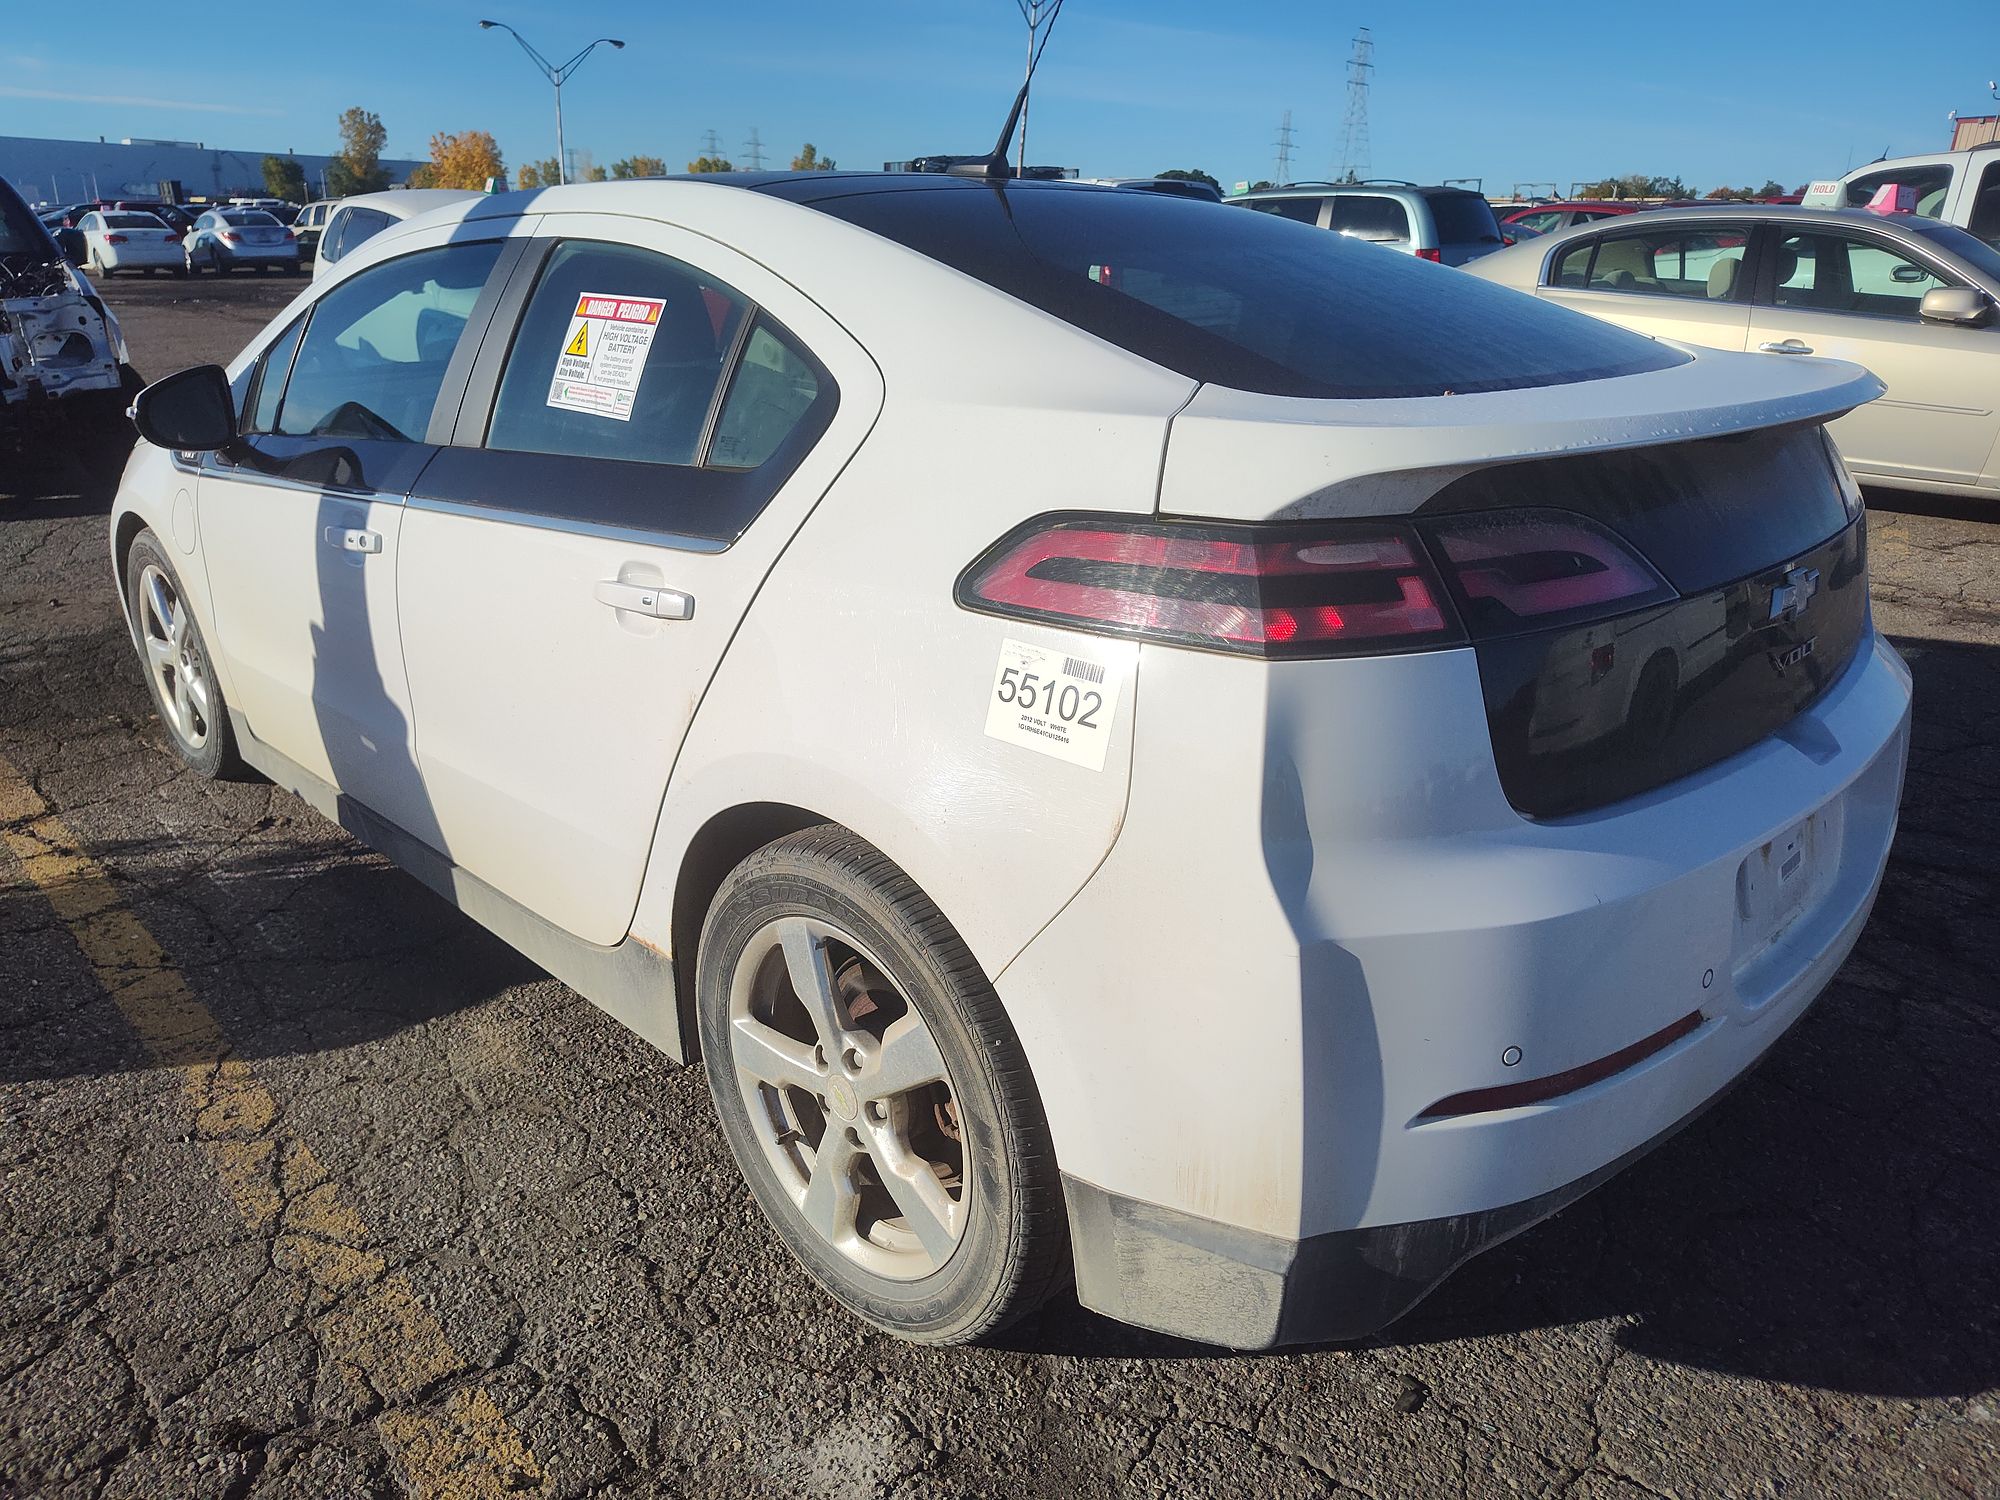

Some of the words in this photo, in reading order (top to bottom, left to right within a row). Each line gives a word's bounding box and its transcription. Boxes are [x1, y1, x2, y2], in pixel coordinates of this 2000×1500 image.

[1813, 184, 1836, 194] HOLD
[586, 299, 617, 317] DANGER
[617, 302, 651, 321] PELIGRO
[610, 324, 625, 332] Vehicle
[625, 326, 643, 334] contains
[603, 332, 619, 342] HIGH
[620, 334, 649, 346] VOLTAGE
[608, 343, 637, 354] BATTERY
[561, 357, 572, 367] High
[559, 367, 568, 376] Alto
[998, 667, 1103, 730] 55102
[1020, 714, 1033, 723] 2012
[1033, 717, 1047, 727] VOLT
[1049, 722, 1068, 734] WHITE
